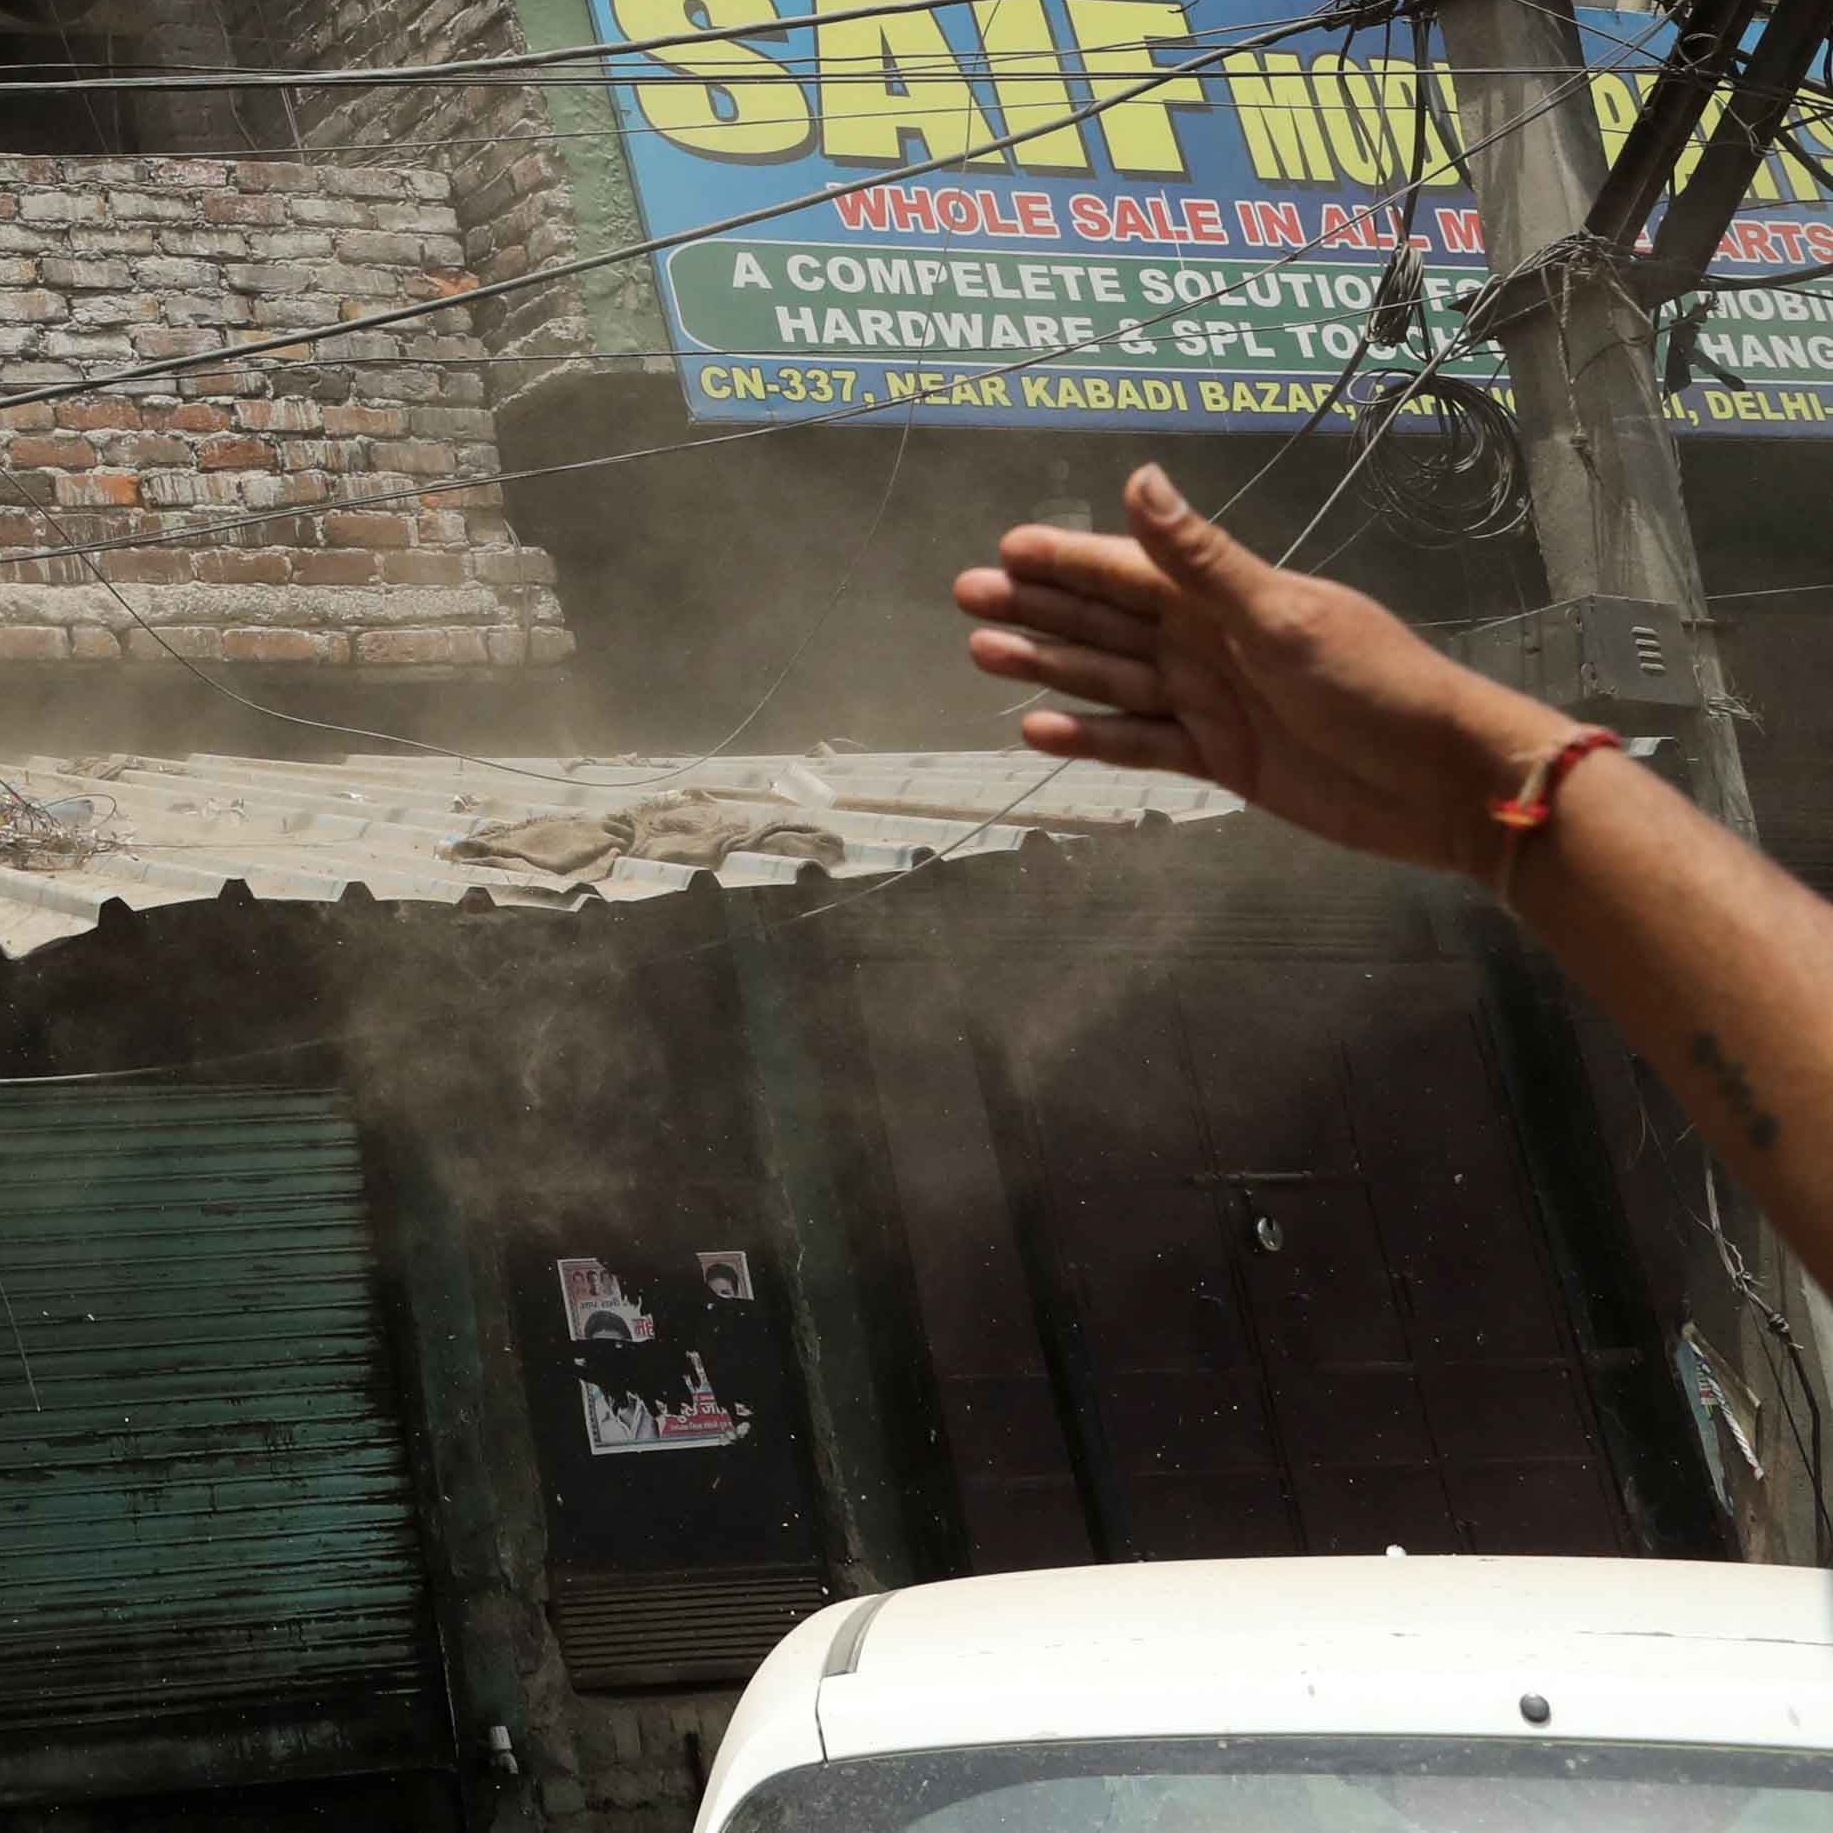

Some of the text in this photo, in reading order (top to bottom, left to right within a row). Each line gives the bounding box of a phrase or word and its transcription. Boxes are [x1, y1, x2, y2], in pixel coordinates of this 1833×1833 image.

[828, 182, 1060, 239] WHOLE
[1071, 193, 1230, 245] SALE
[1235, 200, 1308, 247] IN
[1320, 203, 1432, 252] ALL
[1711, 219, 1833, 264] ARTS
[732, 251, 773, 290] A
[786, 254, 1127, 303] COMPELETE
[1139, 267, 1383, 311] SOLUTIO
[1696, 288, 1833, 322] MOBI
[774, 305, 1102, 354] HARDWARE
[1118, 317, 1157, 355] &
[1171, 319, 1277, 359] SPL
[1699, 333, 1833, 371] HANG
[885, 370, 1013, 408] NEAR
[1020, 375, 1189, 414] KABADI
